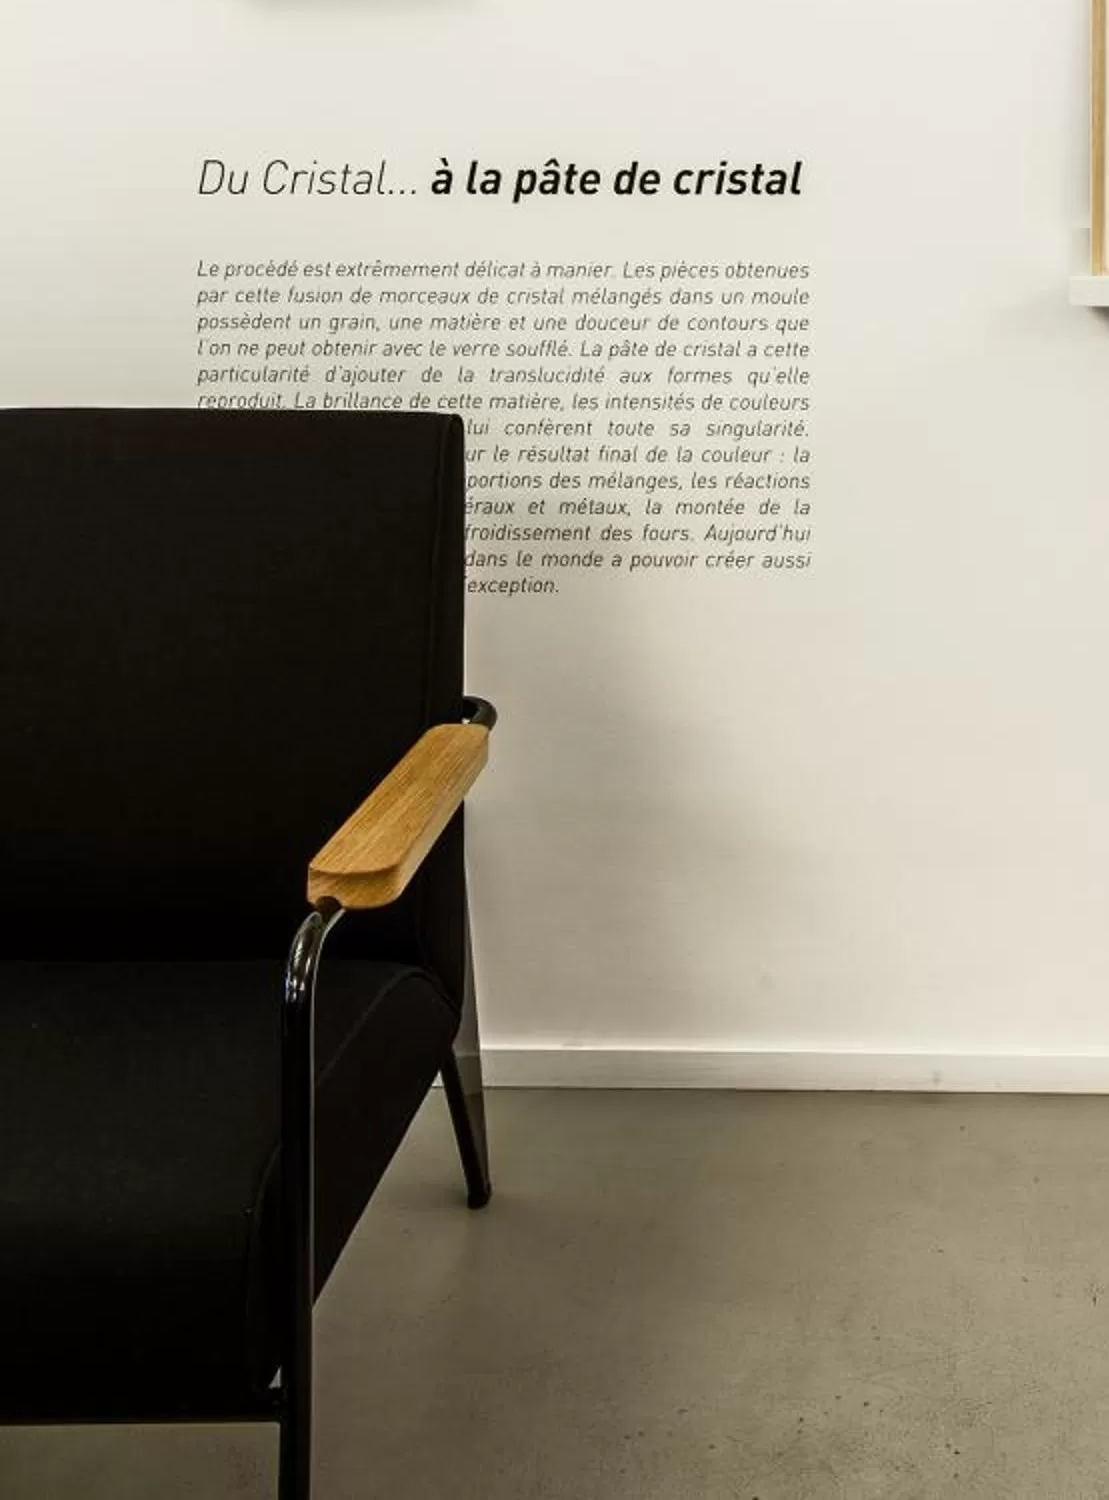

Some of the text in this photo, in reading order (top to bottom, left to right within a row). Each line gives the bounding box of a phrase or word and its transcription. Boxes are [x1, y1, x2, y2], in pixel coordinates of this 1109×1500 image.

[197, 156, 803, 204] Du Cristal... à la pâte de cristal
[196, 311, 809, 335] possèdent un grain, une matière et une douceur de contours que
[196, 364, 810, 388] particularité d'ajouter de la translucidité aux formes qu'elle
[467, 417, 809, 441] lui confèrent toute sa singularité.
